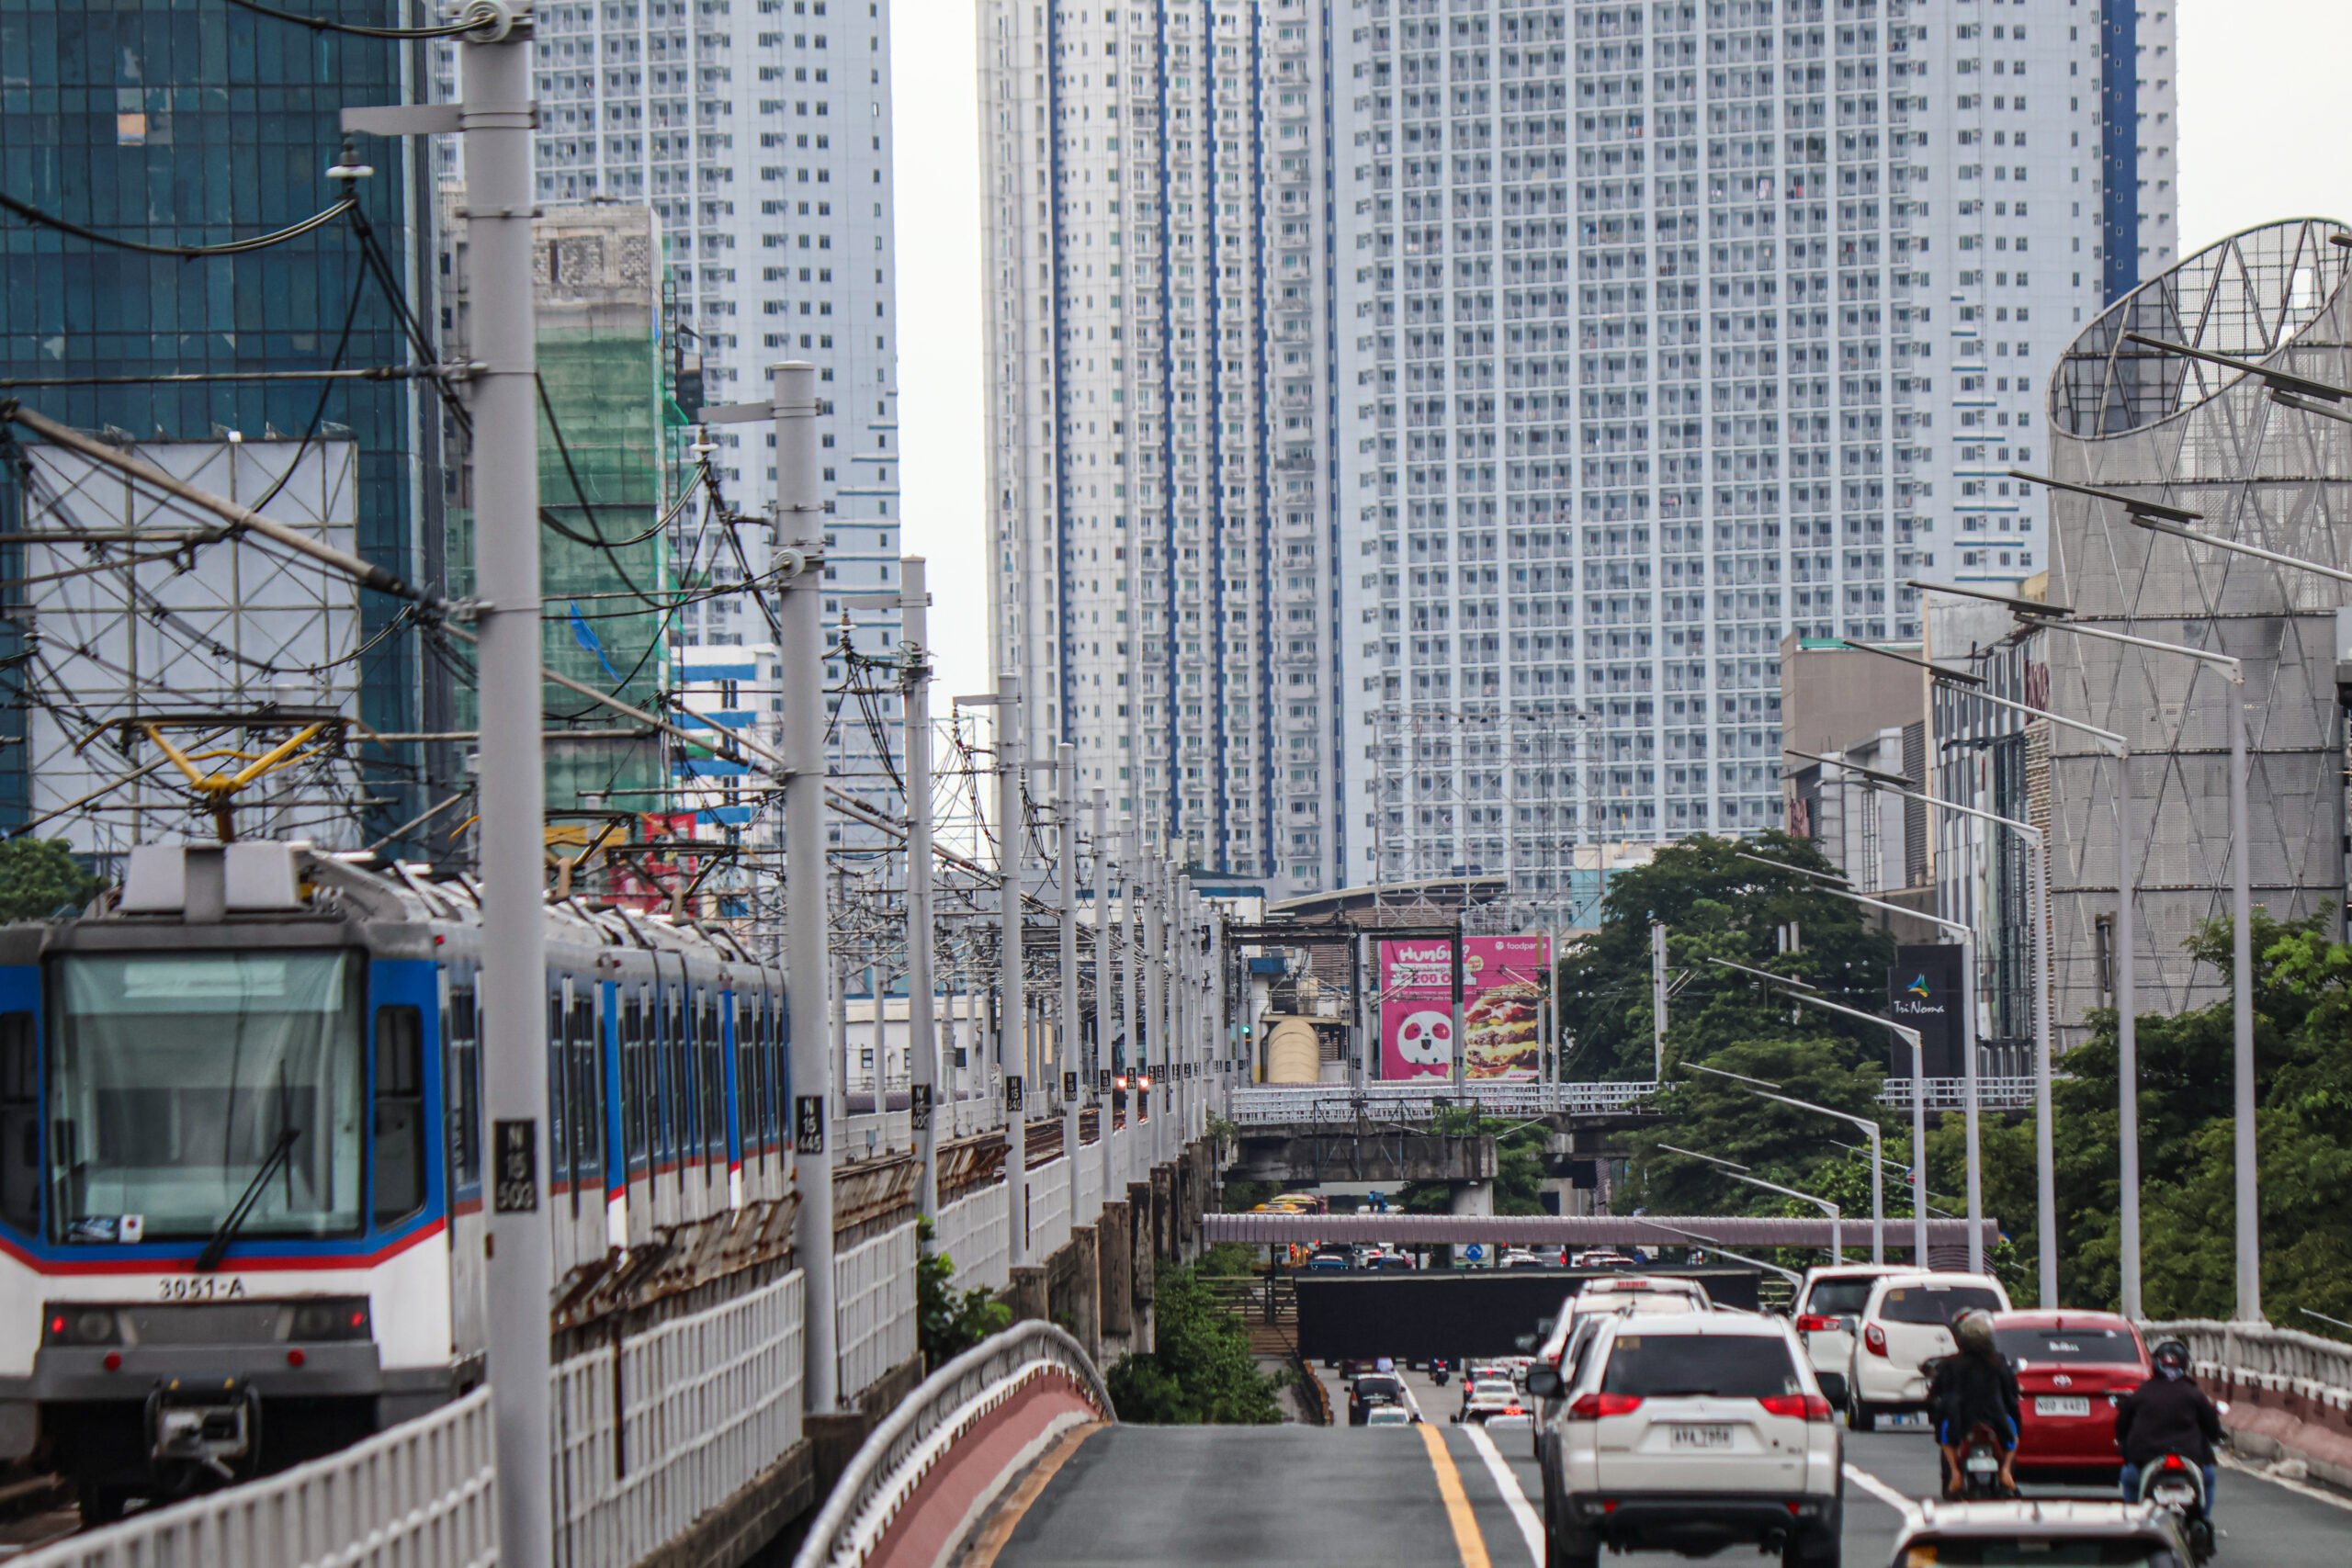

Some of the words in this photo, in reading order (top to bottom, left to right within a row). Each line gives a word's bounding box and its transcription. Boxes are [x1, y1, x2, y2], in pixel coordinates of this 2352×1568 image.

[1507, 942, 1547, 951] foodpana
[805, 1098, 814, 1115] N
[802, 1116, 817, 1134] 15
[507, 1126, 524, 1149] N
[798, 1134, 821, 1153] 445
[507, 1153, 526, 1180] 15
[159, 1277, 246, 1301] 3051-A
